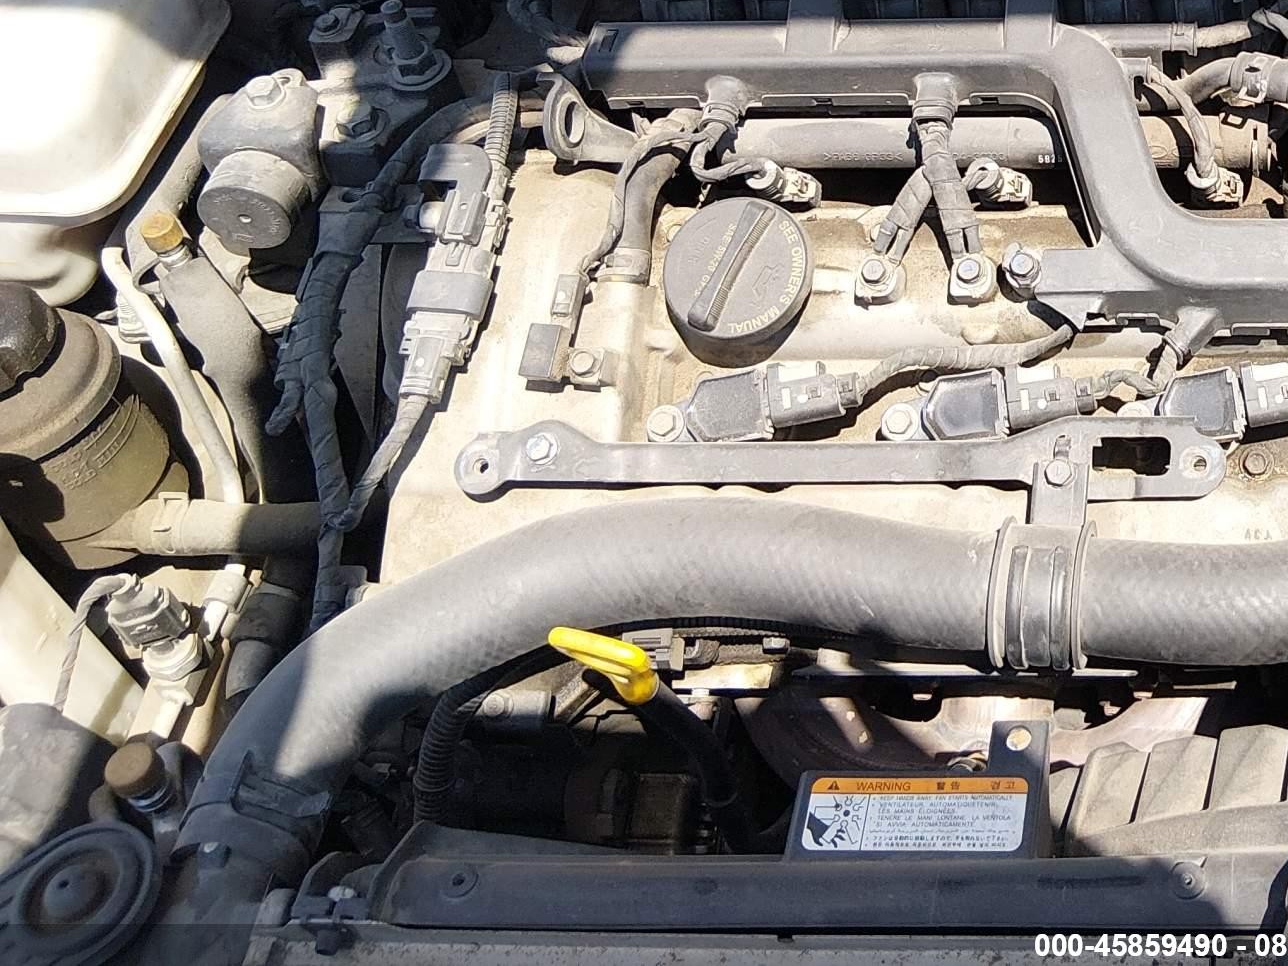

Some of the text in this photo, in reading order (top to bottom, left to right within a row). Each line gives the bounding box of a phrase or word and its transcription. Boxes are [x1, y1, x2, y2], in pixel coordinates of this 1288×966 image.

[728, 220, 804, 333] SEE OWNER'S MANUAL
[856, 782, 911, 791] WARNING
